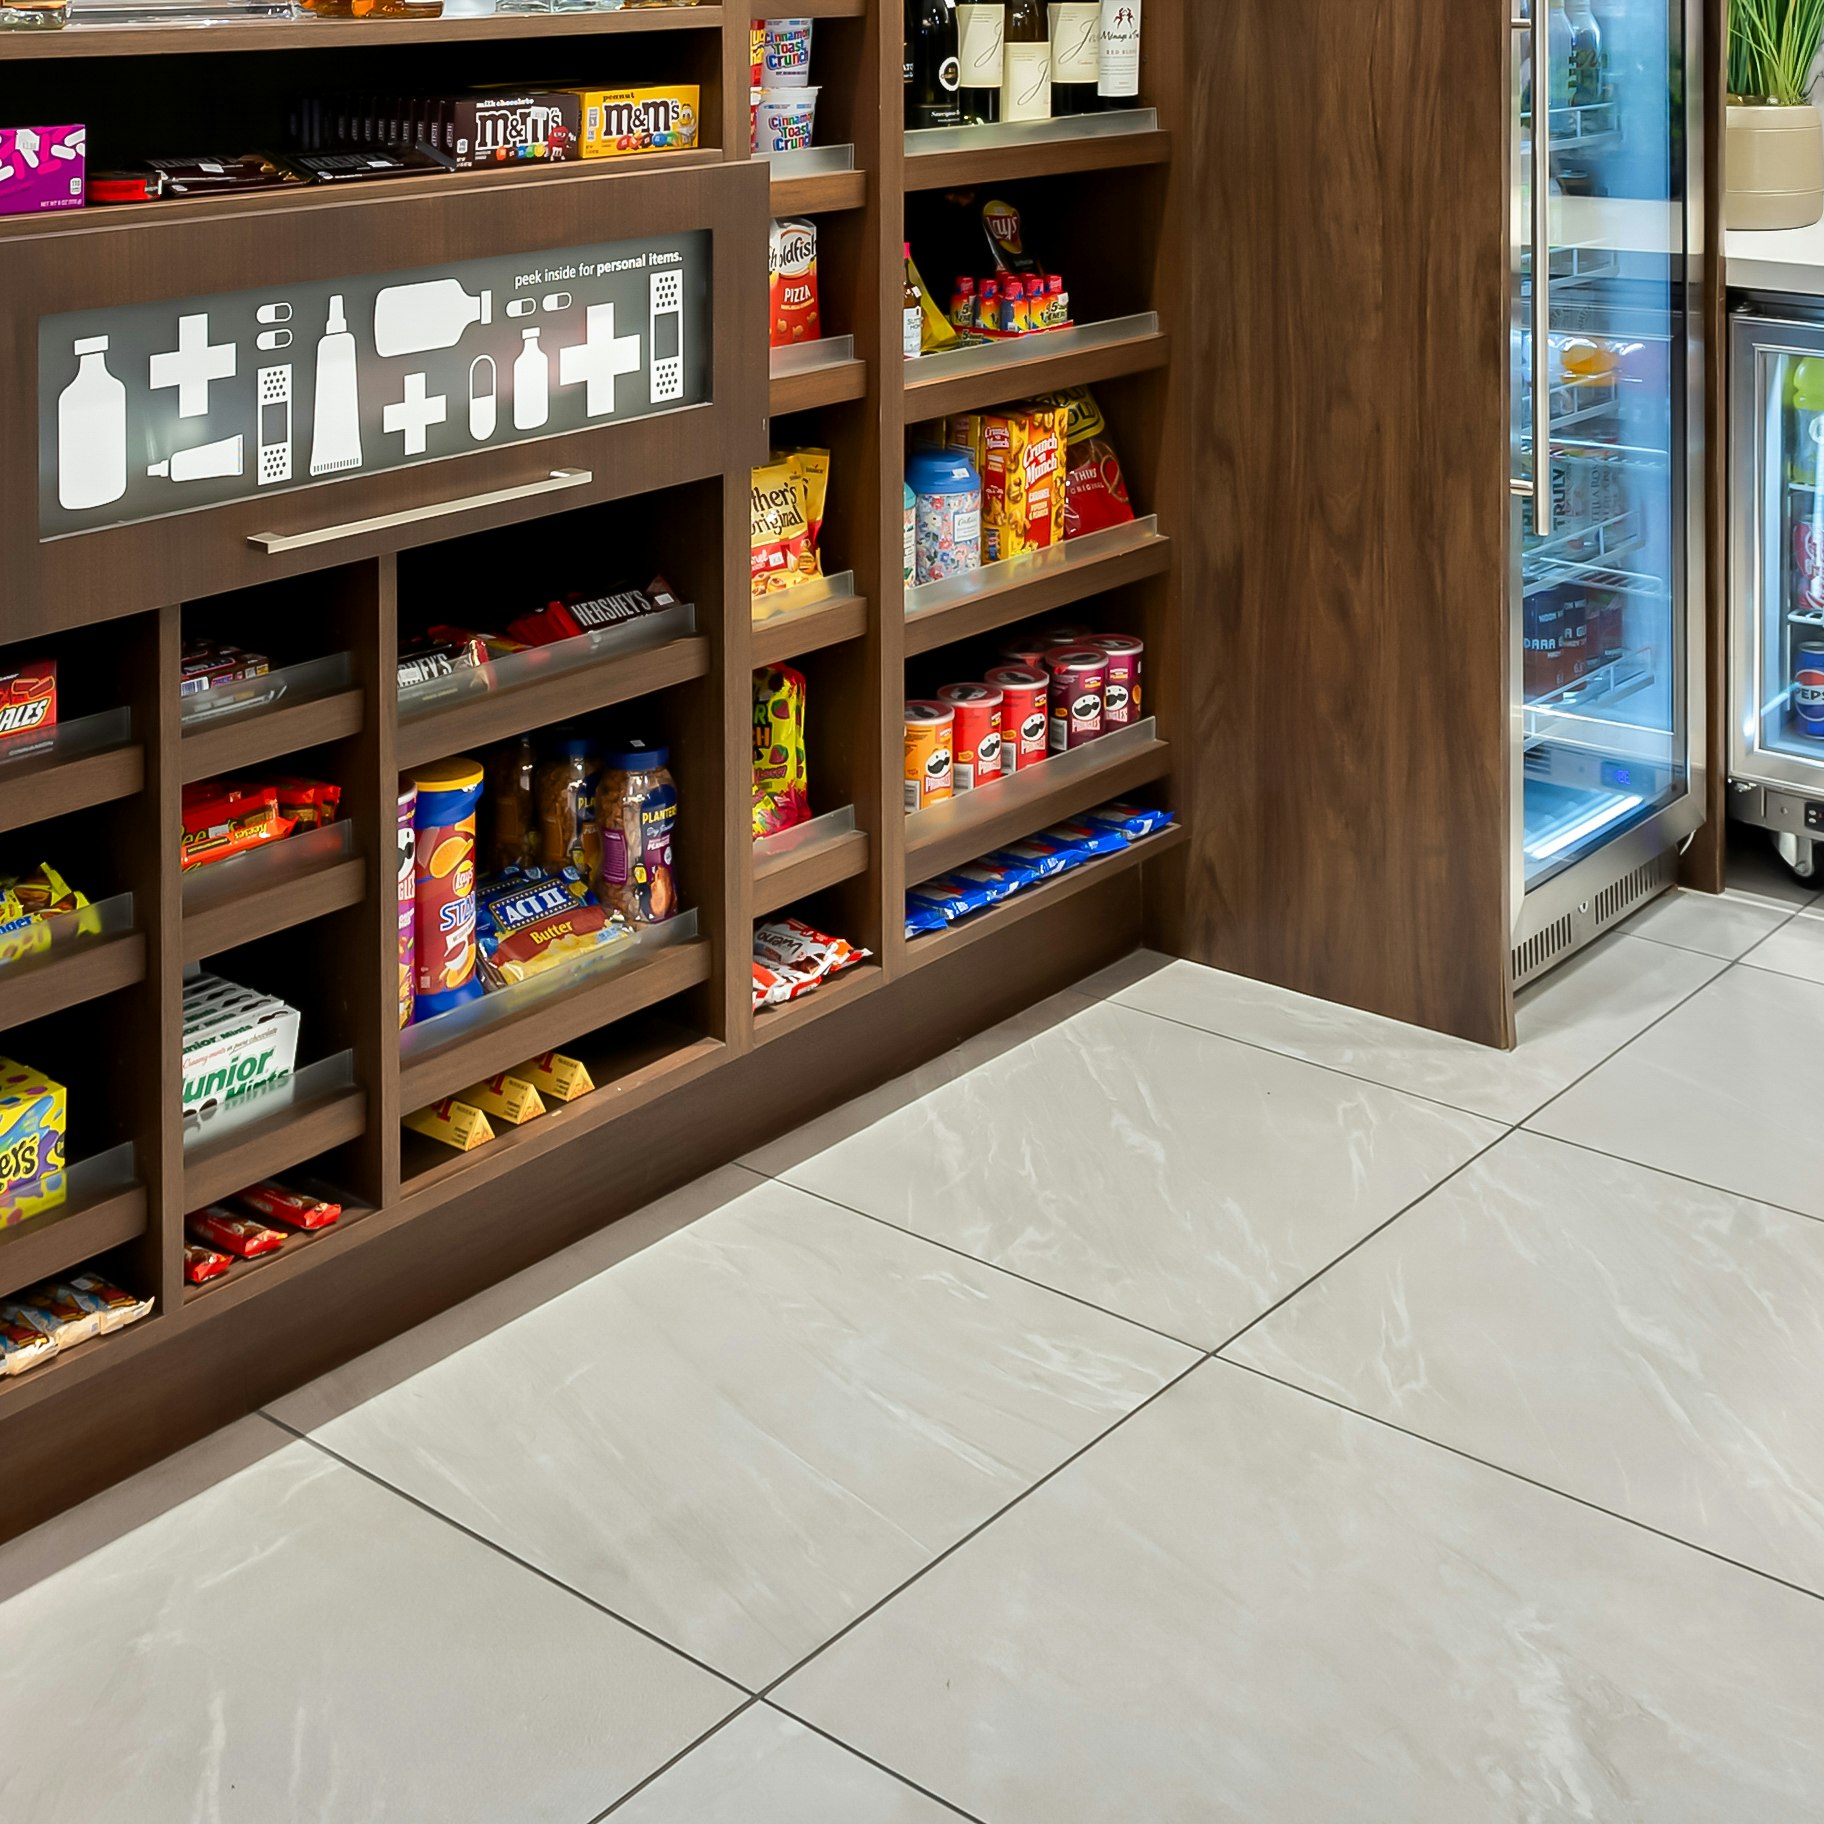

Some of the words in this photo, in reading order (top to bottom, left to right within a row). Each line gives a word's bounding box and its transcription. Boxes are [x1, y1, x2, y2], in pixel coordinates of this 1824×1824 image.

[764, 27, 811, 45] Cinnamon
[774, 39, 805, 55] Toast
[766, 51, 810, 70] Crunch
[602, 92, 635, 102] peanut
[602, 99, 680, 138] m&m's
[514, 270, 543, 290] peek
[544, 266, 576, 283] inside
[578, 262, 595, 277] for
[596, 253, 646, 277] personal
[648, 250, 683, 266] items.
[784, 284, 812, 304] PIZZA
[571, 589, 652, 627] HERSHEY'S
[505, 896, 540, 924] ACT
[539, 888, 567, 908] II
[530, 920, 573, 945] Butter
